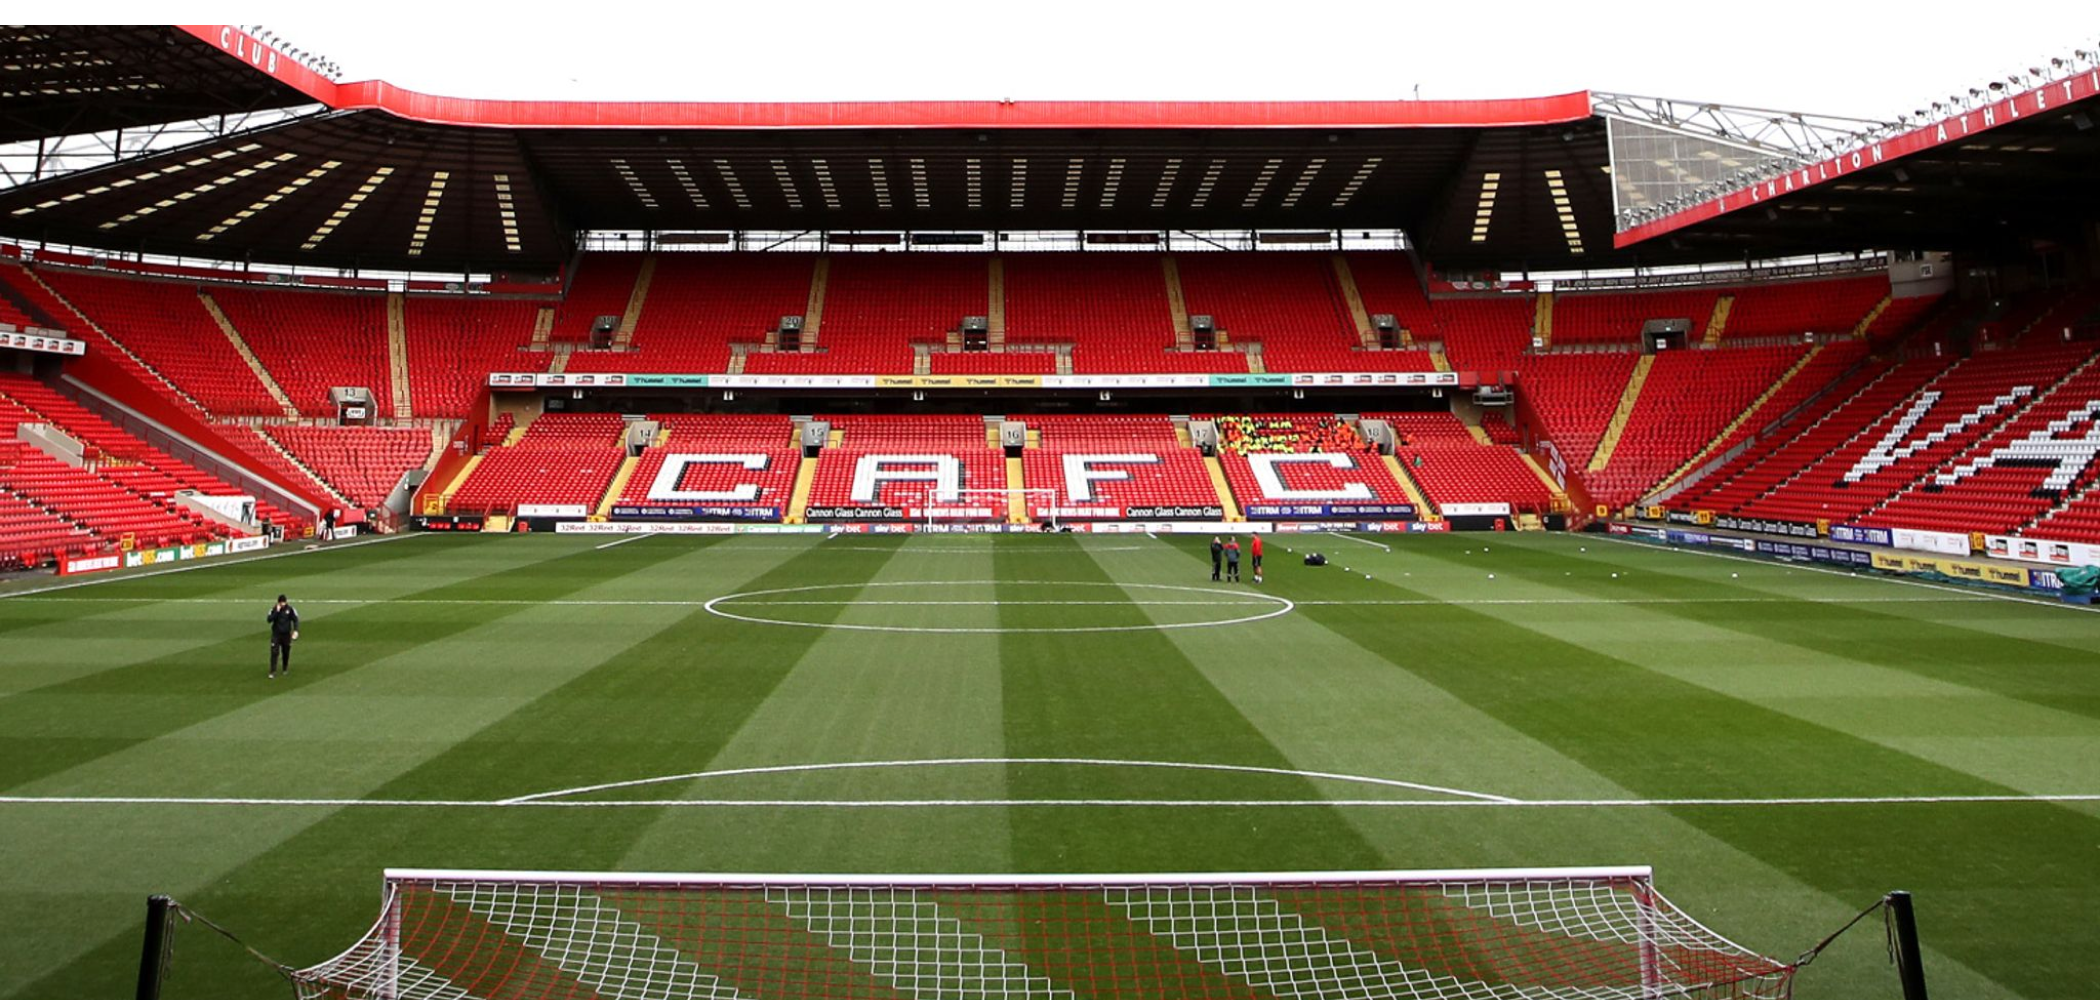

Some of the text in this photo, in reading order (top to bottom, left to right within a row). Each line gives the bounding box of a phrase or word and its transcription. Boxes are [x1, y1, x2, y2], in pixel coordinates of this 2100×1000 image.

[221, 26, 278, 73] CLUB
[1752, 71, 2100, 201] CHARLTON ATHLETI
[345, 388, 356, 397] 13
[640, 429, 651, 438] 14
[811, 428, 824, 437] 15
[1007, 430, 1019, 439] 16
[1196, 429, 1207, 438] 17
[1368, 428, 1380, 437] 18
[807, 507, 832, 517] Cannon
[835, 507, 854, 517] Glass
[855, 507, 881, 517] Cannon
[883, 507, 903, 517] Glass
[1127, 507, 1153, 517] Cannon
[1155, 507, 1174, 517] Glass
[1175, 507, 1202, 517] Cannon
[1203, 507, 1222, 517] Glass
[845, 524, 862, 533] bet
[891, 524, 906, 533] bet
[1367, 522, 1443, 532] sky bet sky bet
